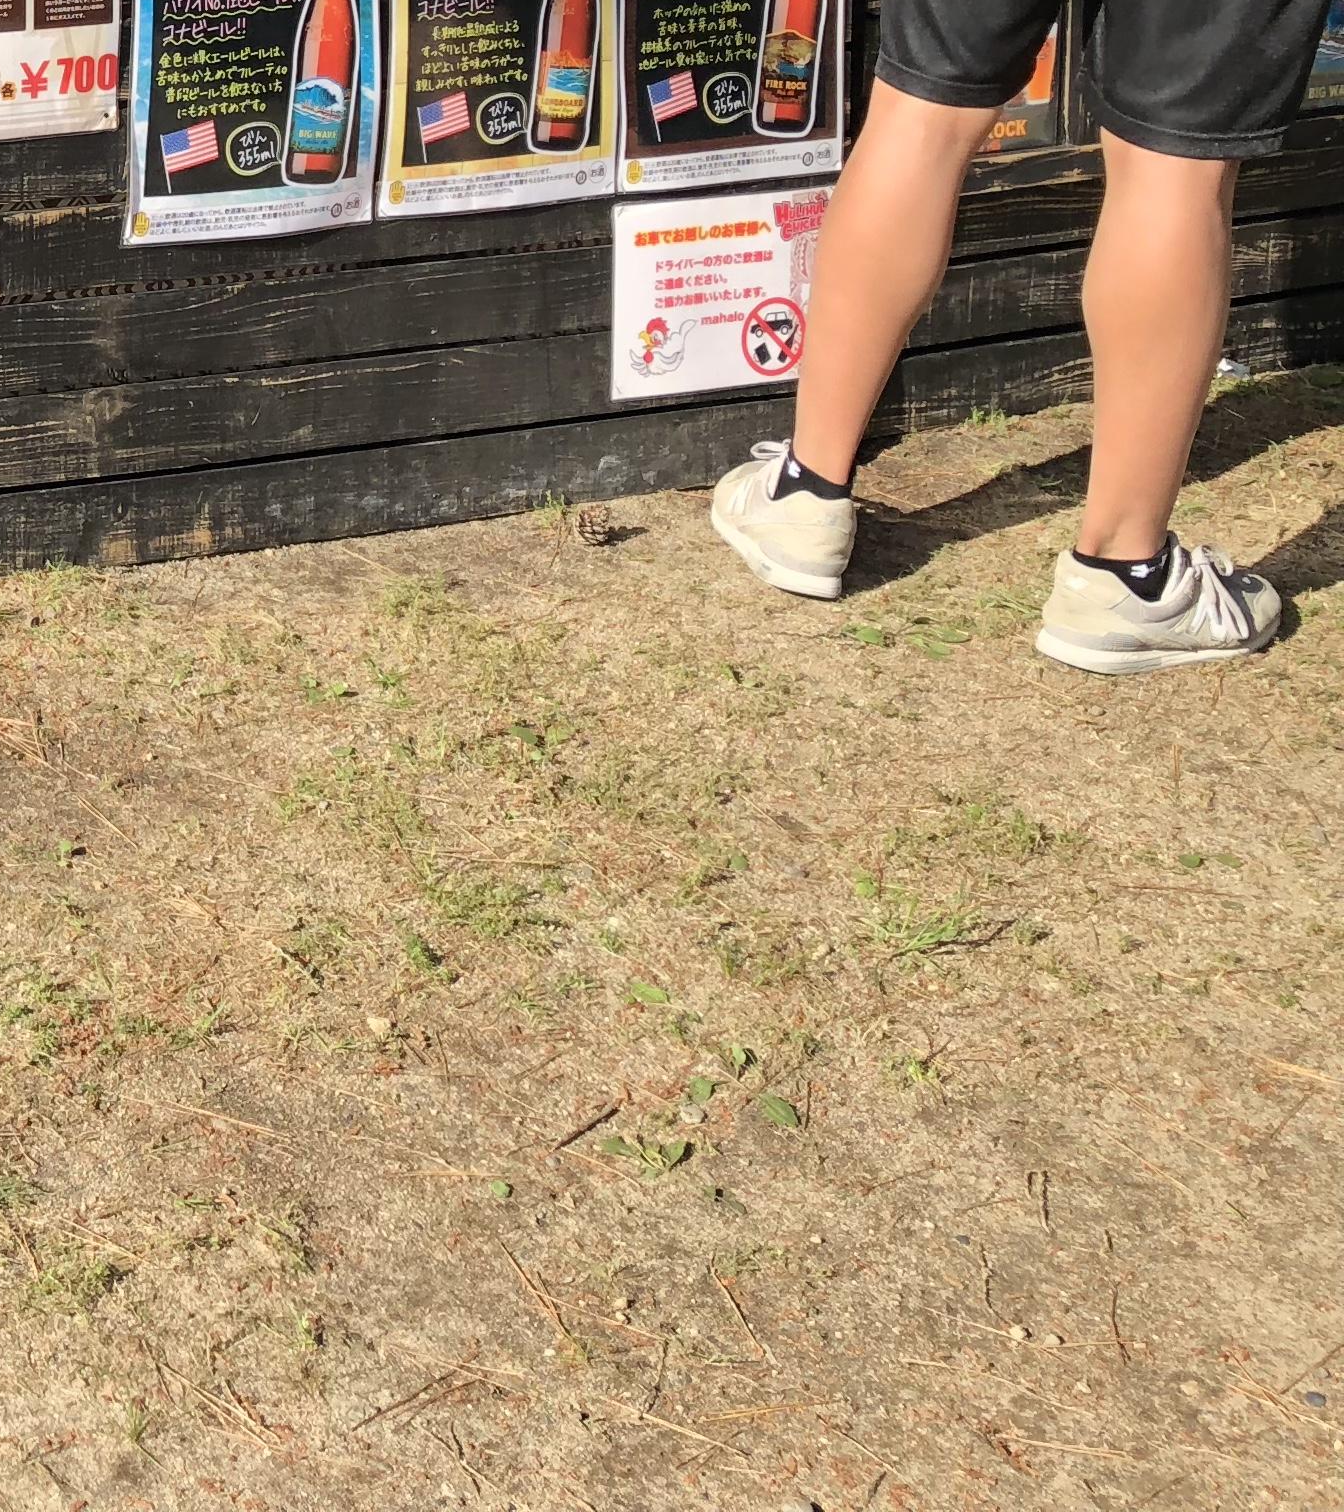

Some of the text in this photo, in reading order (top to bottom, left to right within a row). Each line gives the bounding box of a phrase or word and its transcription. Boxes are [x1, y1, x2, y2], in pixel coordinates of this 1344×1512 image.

[714, 80, 740, 96] びん
[764, 79, 808, 91] FIRE ROCK
[1308, 85, 1327, 100] BIG
[488, 100, 515, 117] びん
[988, 119, 1029, 140] OCK
[239, 130, 268, 148] びん
[701, 311, 746, 326] mahalo
